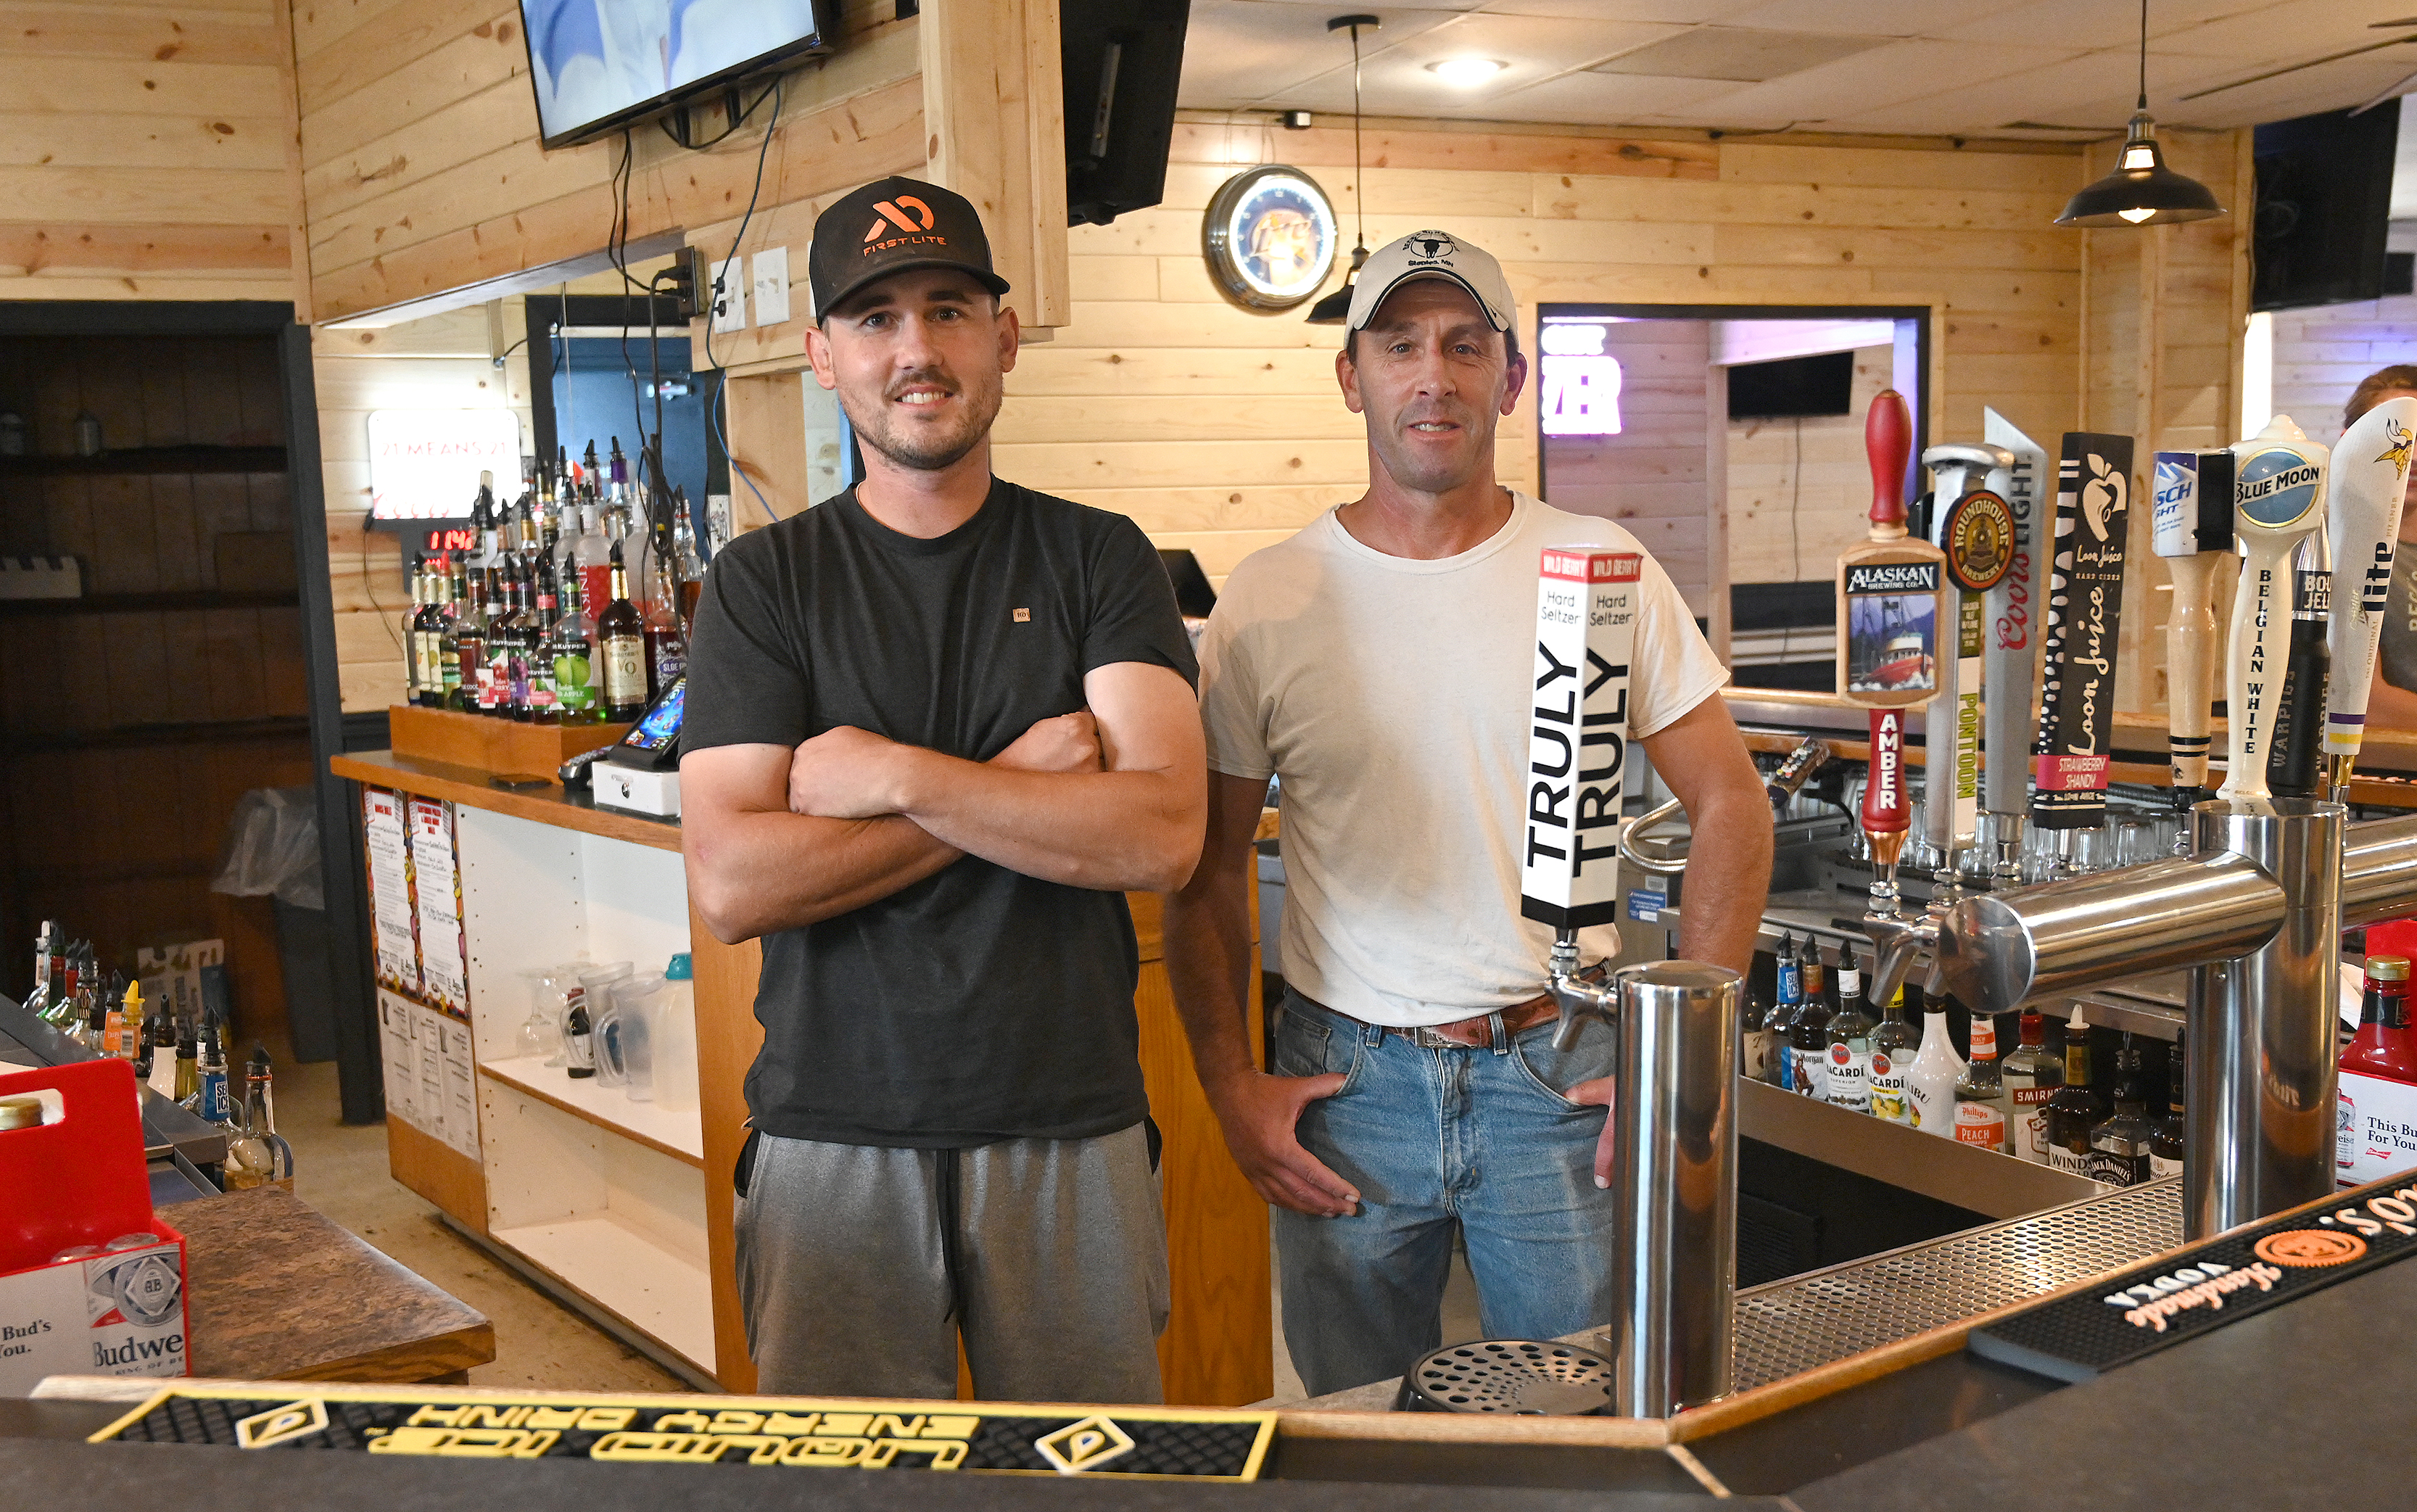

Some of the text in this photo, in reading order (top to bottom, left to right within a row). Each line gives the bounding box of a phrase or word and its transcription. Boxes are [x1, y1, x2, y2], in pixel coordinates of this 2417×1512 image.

[862, 235, 947, 257] FIRST LITE
[383, 442, 506, 455] 21 MEANS 21
[2236, 467, 2320, 504] BLUE MOON
[1954, 500, 2009, 547] ROUNDHOUSE
[1542, 554, 1587, 578] WILD BERRY
[1593, 556, 1638, 578] WILD BERRY
[2076, 544, 2123, 568] Loon Juice
[1847, 566, 1935, 592] ALASKAN
[1961, 563, 2000, 582] BREWERY
[2362, 542, 2394, 612] lite
[576, 556, 592, 619] KINKY
[1868, 582, 1904, 590] BREWING
[1547, 590, 1575, 608] Hard
[1595, 594, 1627, 609] Hard
[1996, 553, 2030, 650] Coors
[1541, 607, 1581, 626] Seltzer
[1590, 611, 1634, 627] Seltzer
[2366, 619, 2379, 665] ORIGINAL
[616, 658, 637, 675] VO
[664, 662, 679, 672] SLOE
[2067, 586, 2110, 756] Loon Juice
[2244, 570, 2272, 754] BELGIAN WHITE
[1526, 640, 1577, 868] TRULY
[1957, 693, 1978, 799] PONTOON
[1571, 647, 1629, 878] TRULY
[1878, 714, 1898, 810] AMBER
[2059, 757, 2107, 772] STRAWBERRY
[2063, 773, 2097, 790] SHANDY
[1801, 1053, 1824, 1065] Morgan
[1962, 1107, 1988, 1119] Phillips
[2367, 1116, 2397, 1133] This
[1962, 1128, 1990, 1141] PEACH
[2367, 1129, 2389, 1144] For
[2091, 1160, 2105, 1173] JACK
[2105, 1158, 2132, 1182] DANIEL'S
[2103, 1261, 2232, 1309] VODKA
[2124, 1263, 2282, 1333] Handmade
[2, 1318, 51, 1341] Bud's
[408, 1405, 980, 1439] ENERGY DRINK
[368, 1426, 970, 1469] LIQUID ICE
